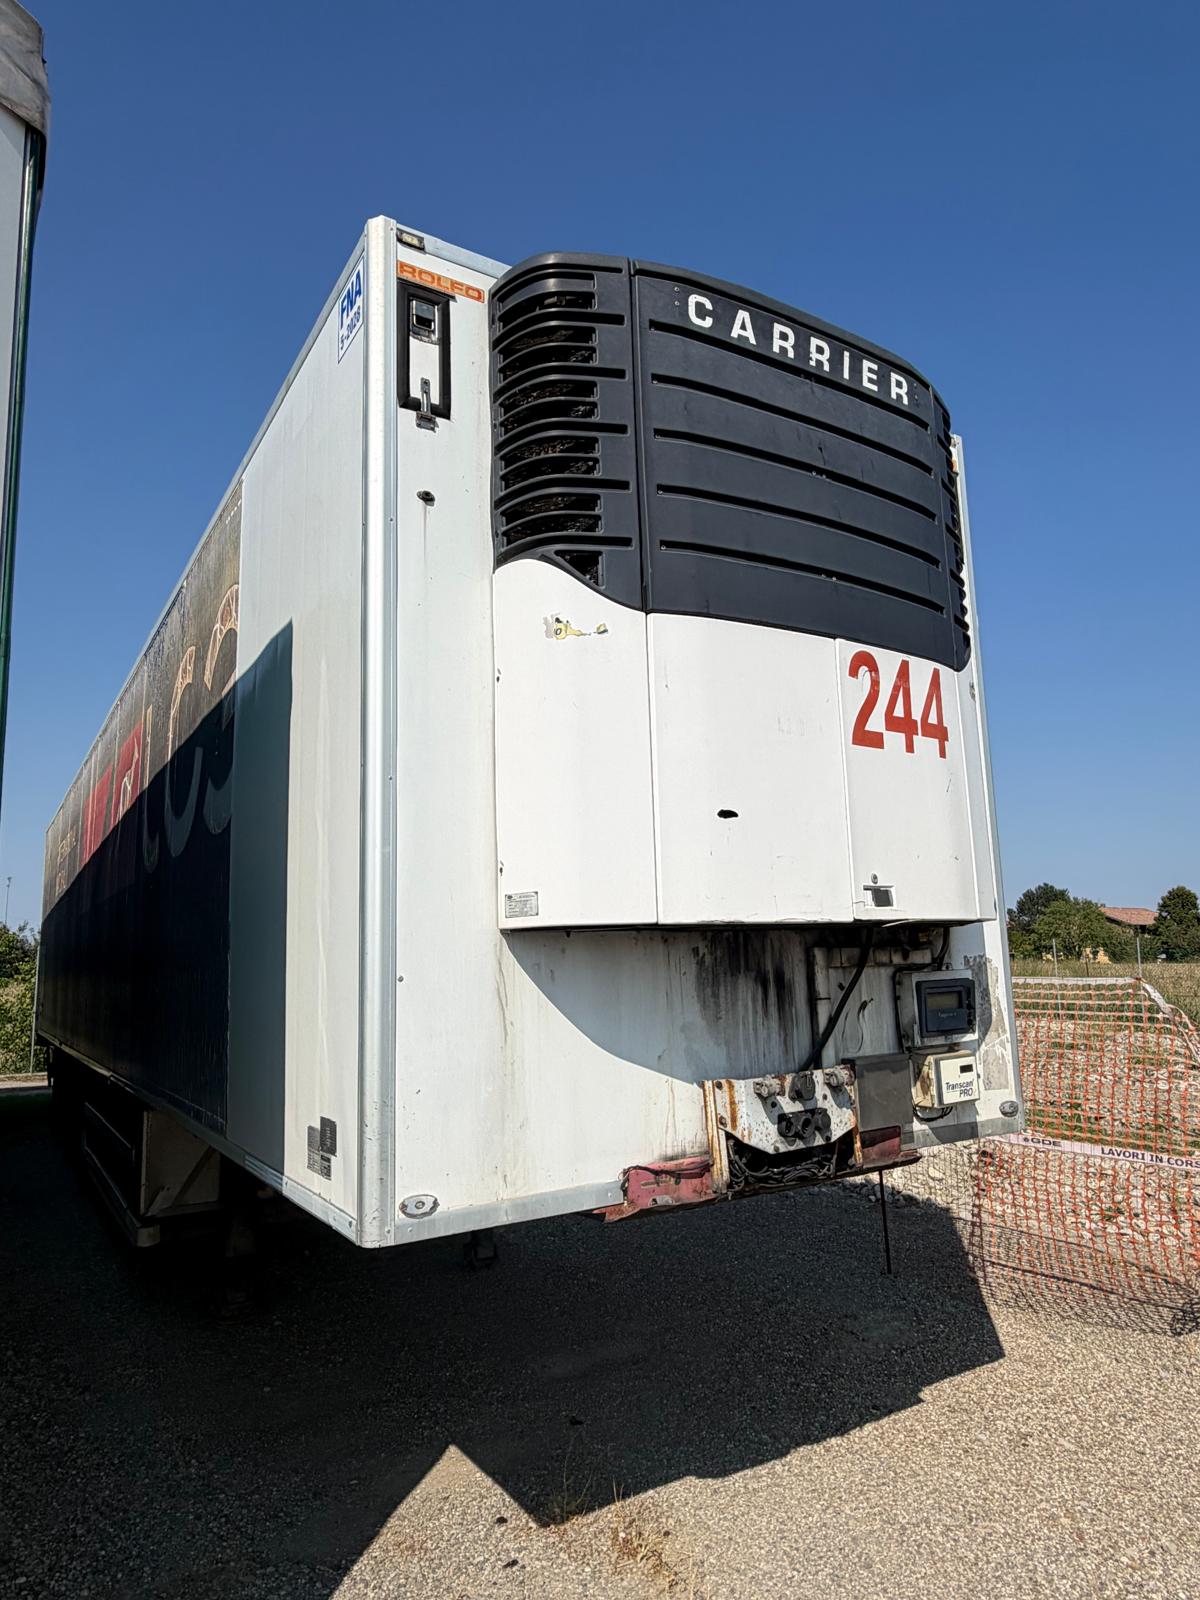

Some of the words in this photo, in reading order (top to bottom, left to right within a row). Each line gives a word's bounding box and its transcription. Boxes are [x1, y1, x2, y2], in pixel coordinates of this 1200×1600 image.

[340, 270, 362, 330] FNA
[399, 261, 483, 302] ROLFO
[687, 293, 909, 405] CARRIER
[848, 650, 949, 759] 244
[945, 1080, 974, 1092] Transcan
[959, 1087, 973, 1097] PRO
[1101, 1147, 1146, 1161] LAVORI
[1150, 1154, 1163, 1163] IN
